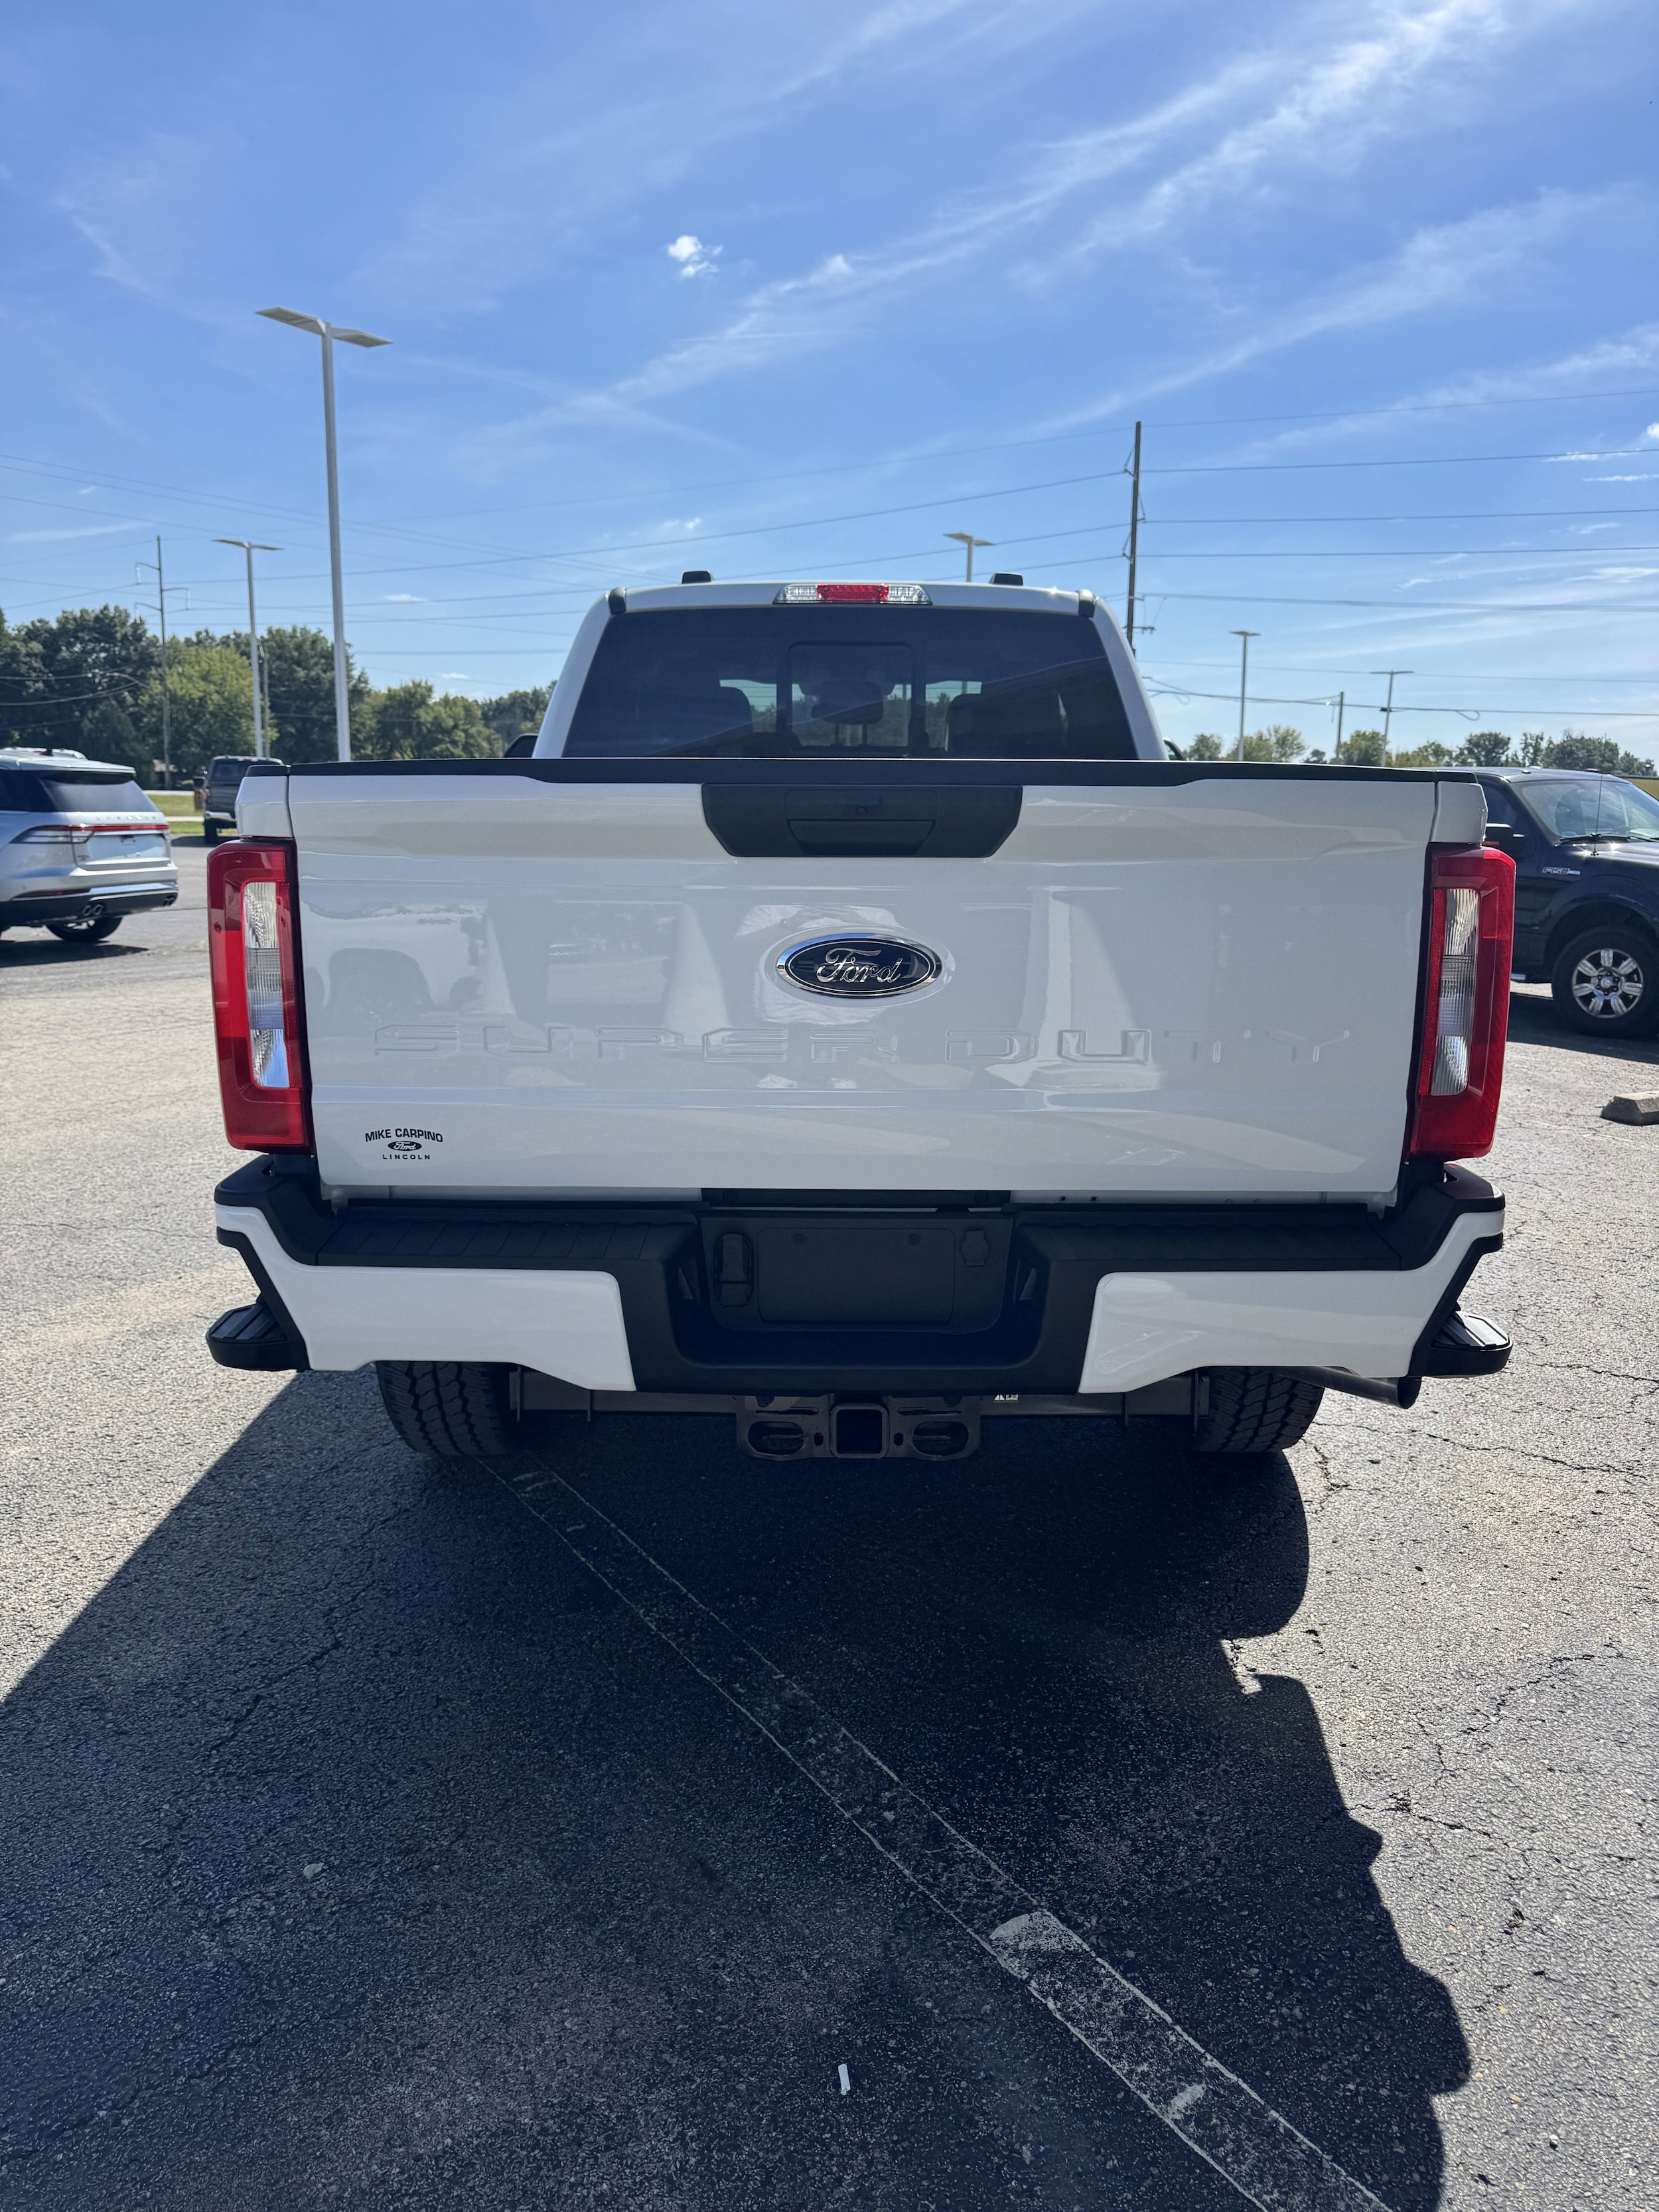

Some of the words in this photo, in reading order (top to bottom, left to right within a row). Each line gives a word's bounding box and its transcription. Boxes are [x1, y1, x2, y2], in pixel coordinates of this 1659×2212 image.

[816, 947, 904, 984] Ford
[374, 1023, 898, 1064] SUPER
[945, 1028, 1350, 1064] DUTY
[365, 1129, 392, 1142] MIKE
[395, 1128, 443, 1142] CARPINO
[393, 1141, 417, 1150] Ford
